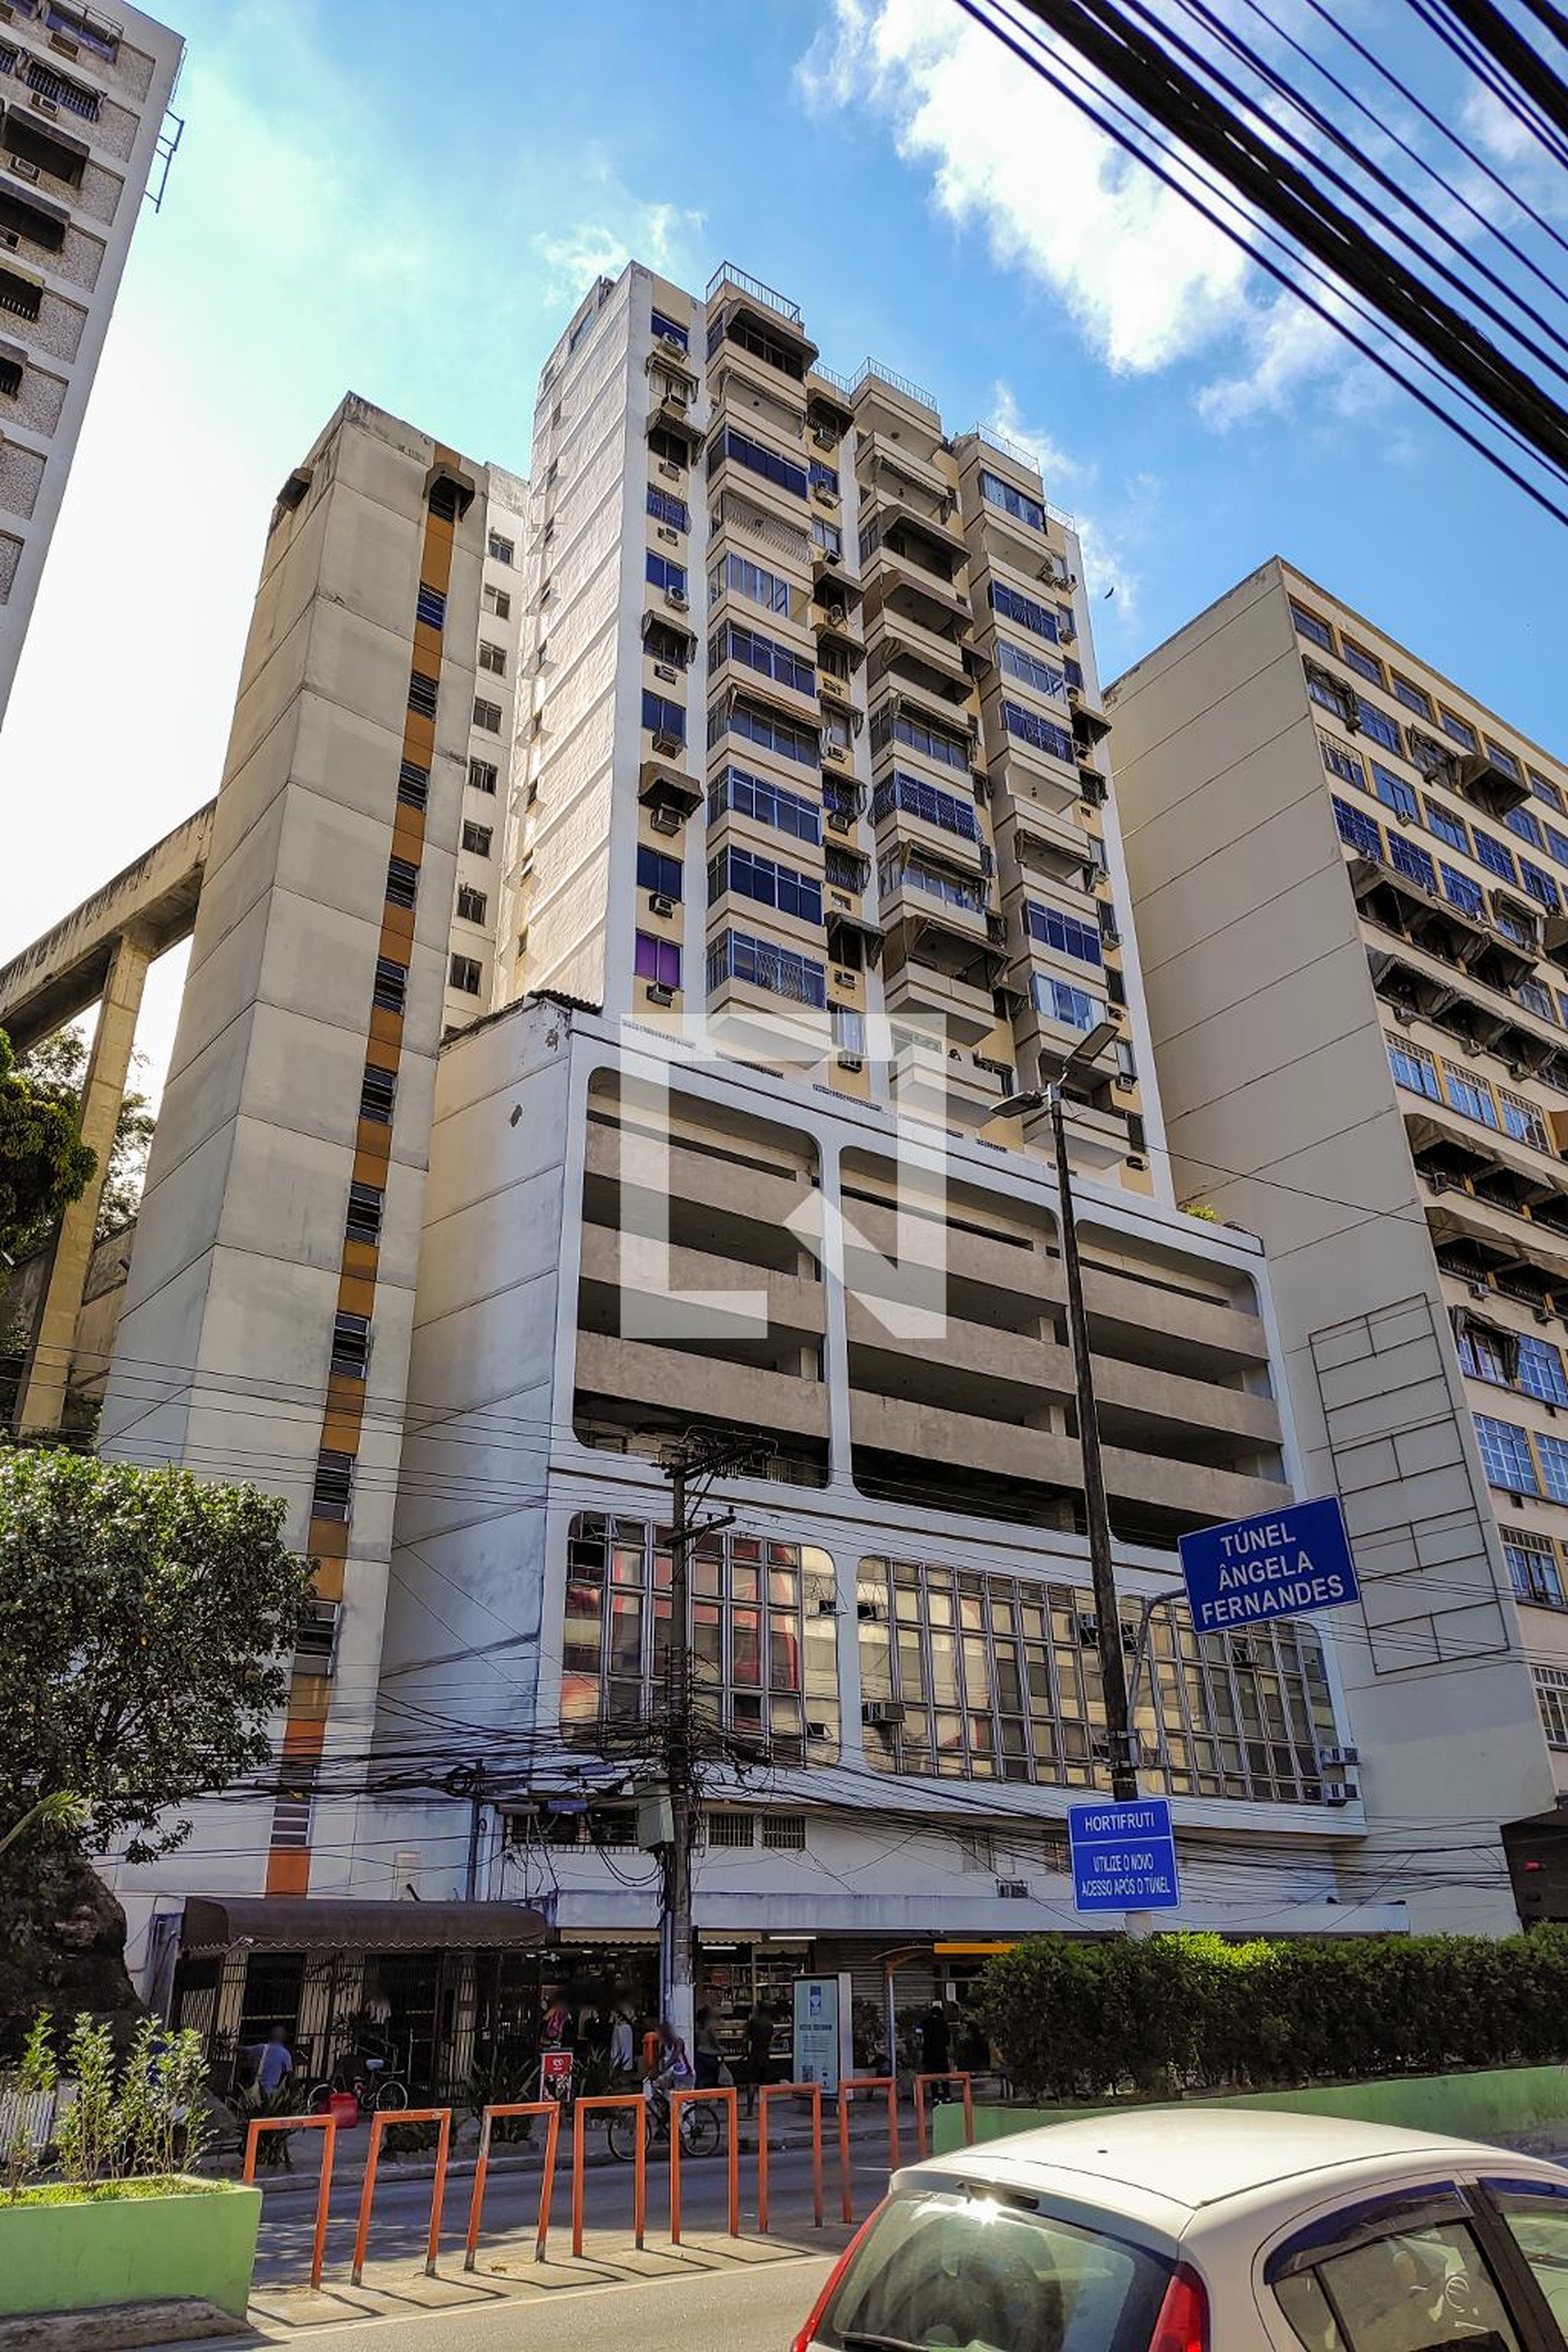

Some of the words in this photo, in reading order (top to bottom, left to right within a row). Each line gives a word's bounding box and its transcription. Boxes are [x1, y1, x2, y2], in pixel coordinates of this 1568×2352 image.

[1220, 1522, 1296, 1557] TÚNEL
[1219, 1550, 1313, 1591] ÂNGELA
[1202, 1575, 1344, 1625] FERNANDES
[1085, 1812, 1155, 1832] HORTIFRUTI
[1093, 1855, 1123, 1872] UTILIZE
[1123, 1853, 1129, 1871] O
[1131, 1853, 1154, 1870] NOVO
[1082, 1879, 1112, 1897] ACESSO
[1114, 1874, 1135, 1895] APÓS
[1137, 1878, 1143, 1895] O
